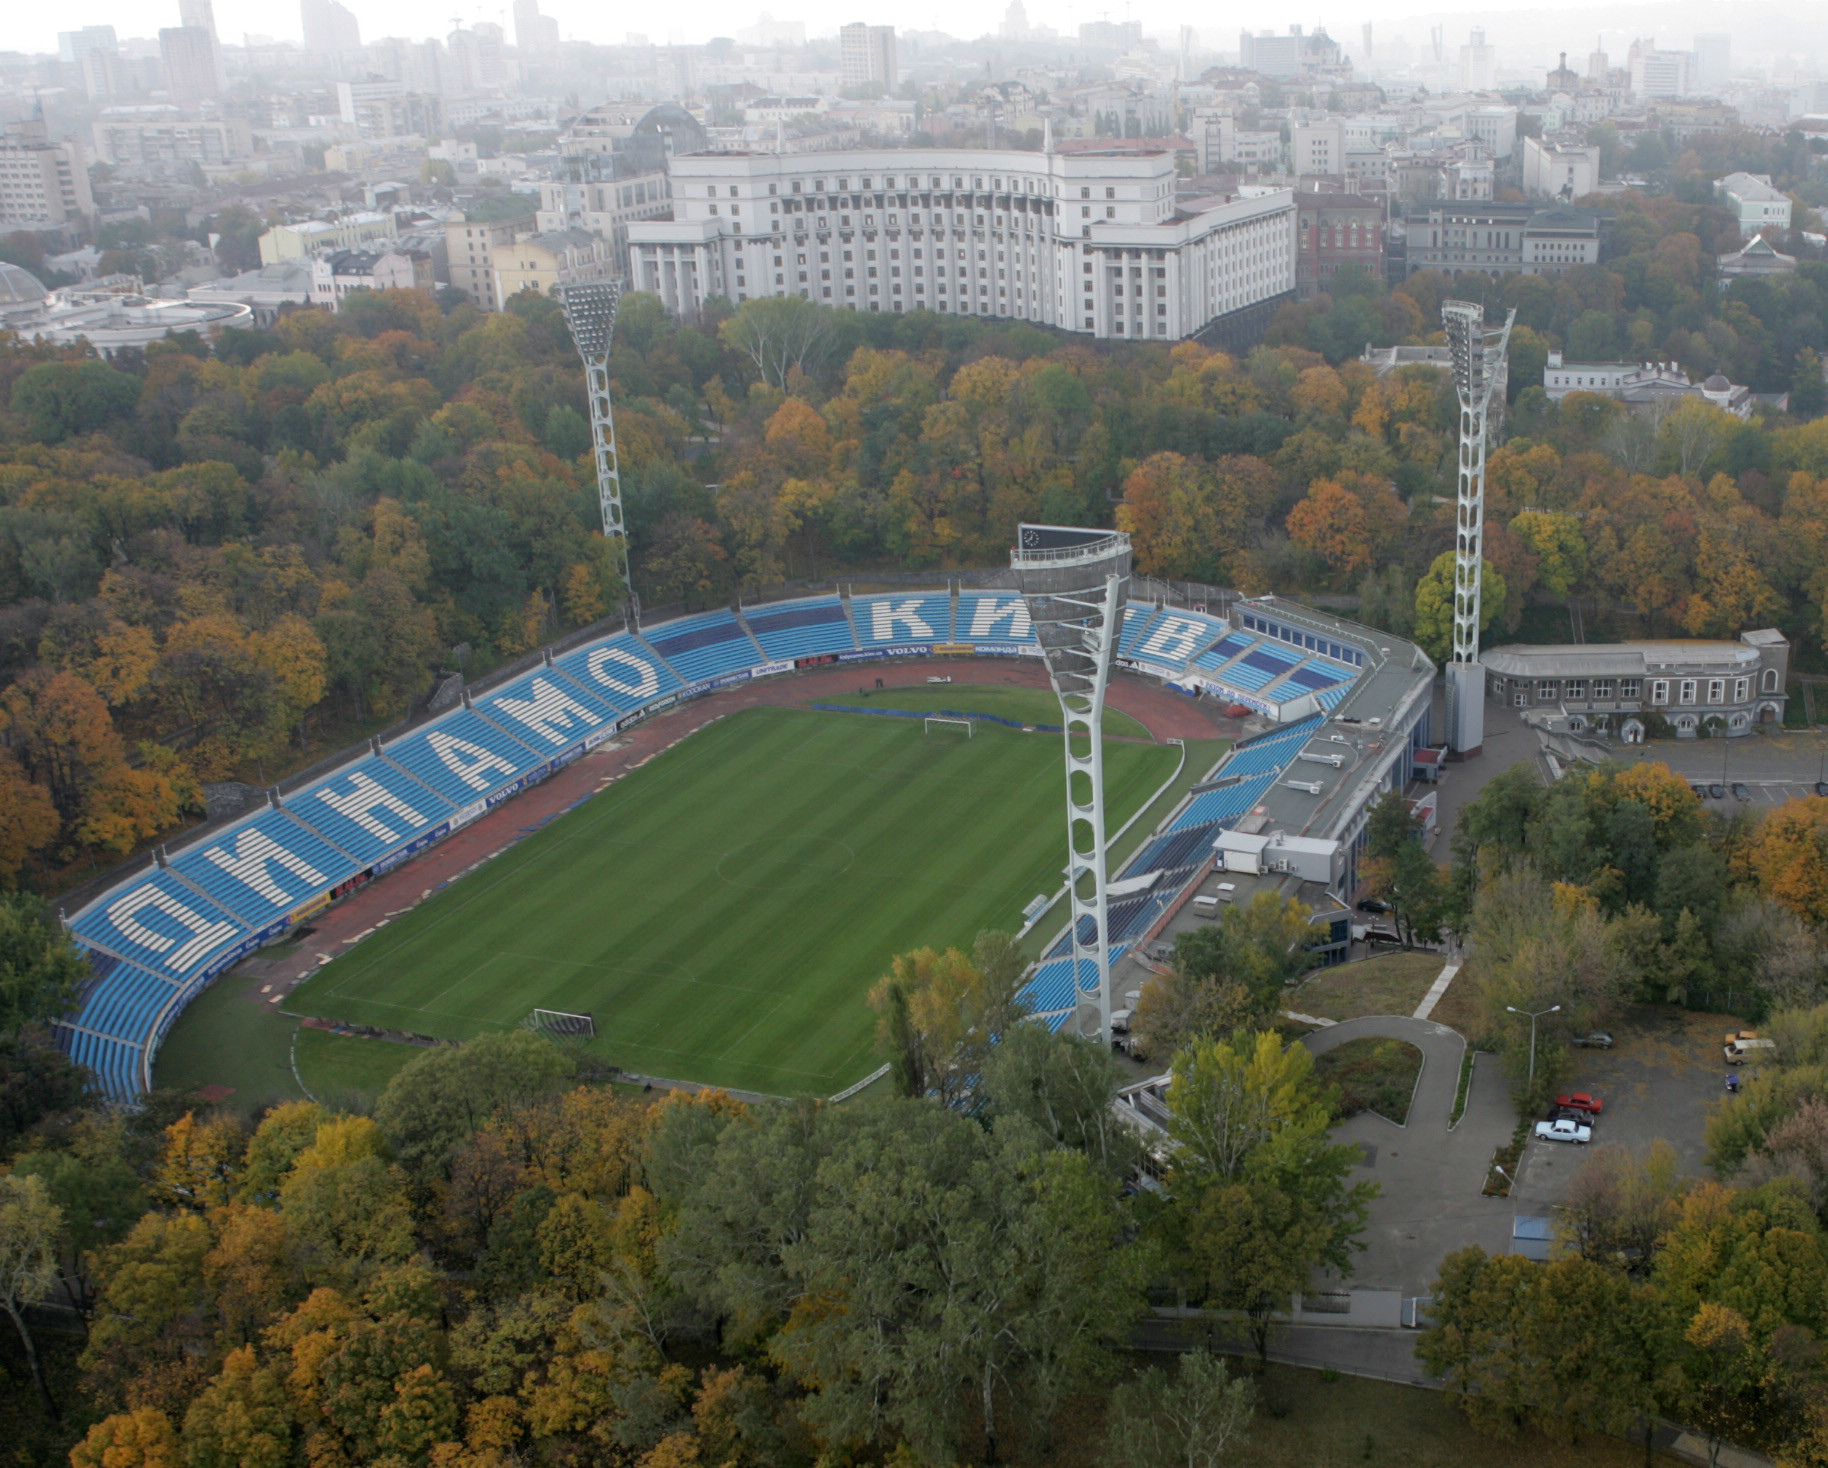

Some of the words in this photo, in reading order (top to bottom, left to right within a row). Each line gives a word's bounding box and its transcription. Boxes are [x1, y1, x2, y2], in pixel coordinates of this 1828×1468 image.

[871, 598, 1207, 660] КИВ
[886, 646, 928, 656] VOLVO
[107, 647, 660, 973] ДИНАМО
[488, 783, 519, 804] VOLVO
